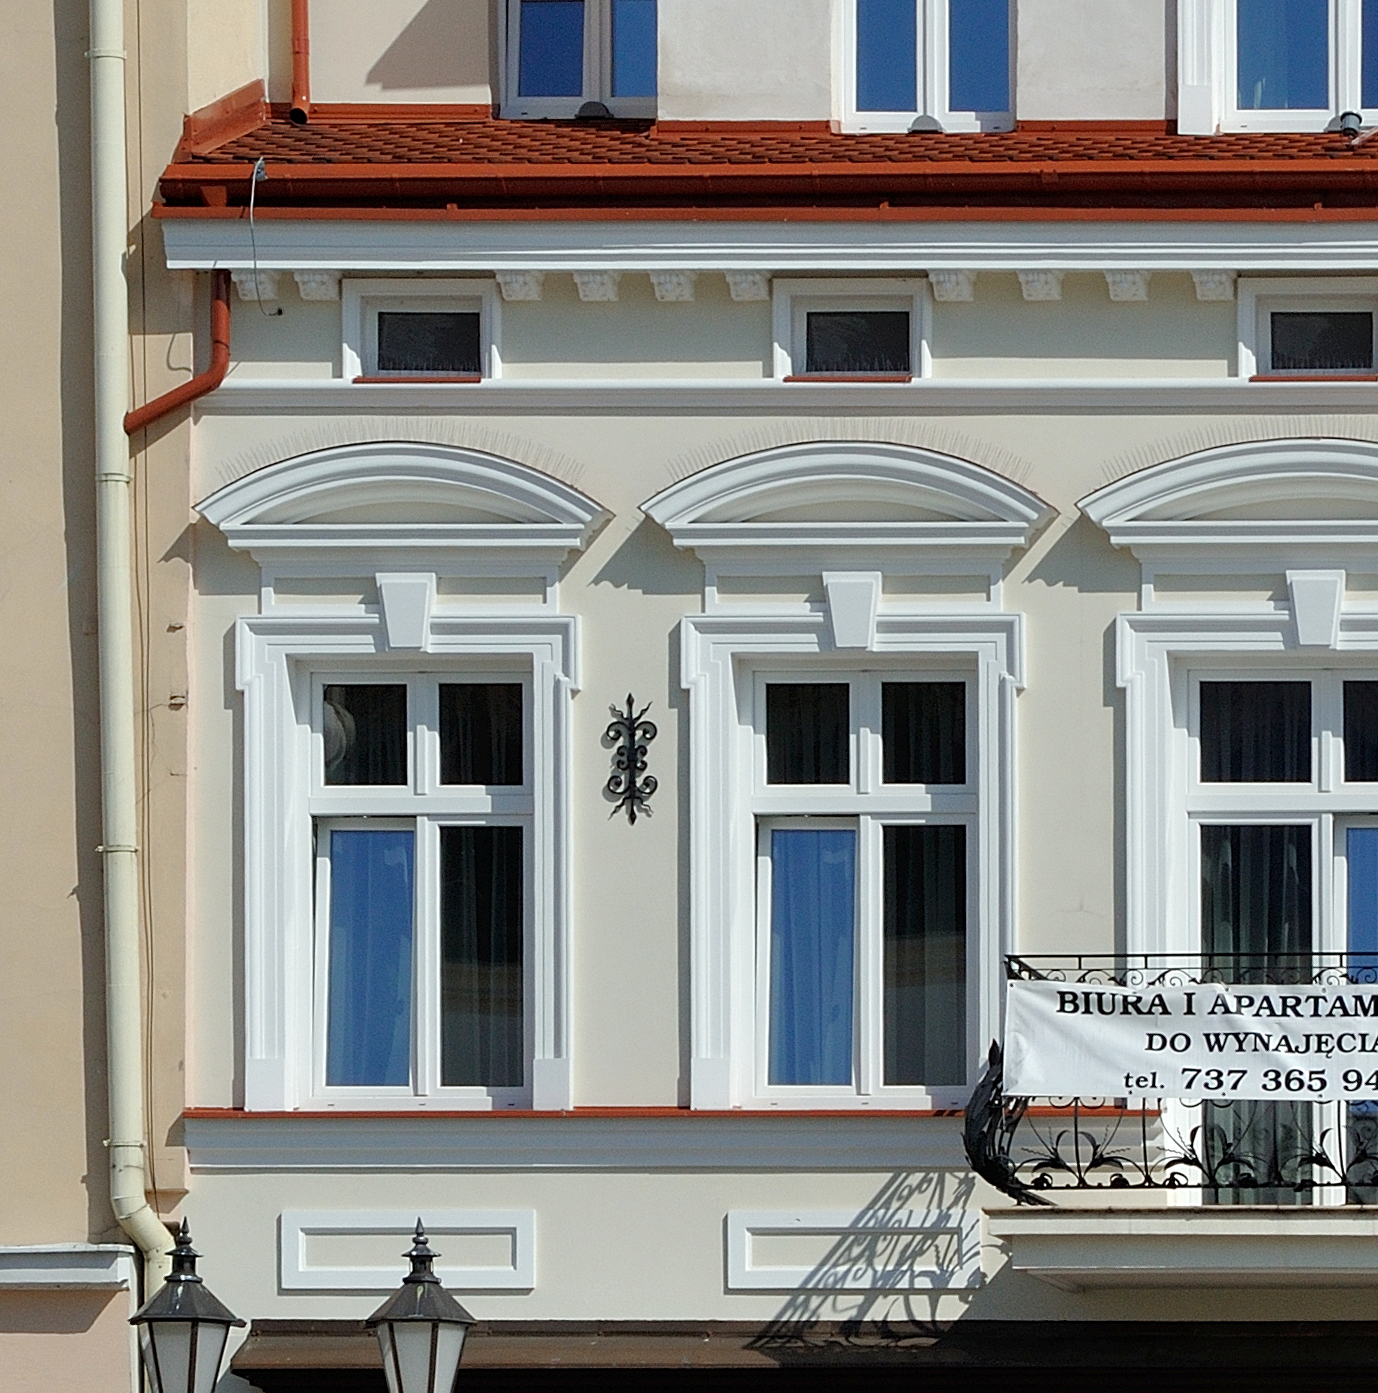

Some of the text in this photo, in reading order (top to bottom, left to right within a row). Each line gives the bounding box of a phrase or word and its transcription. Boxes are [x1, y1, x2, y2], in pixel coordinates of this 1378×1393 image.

[1056, 990, 1172, 1016] BIURA
[1182, 992, 1197, 1017] I
[1144, 1032, 1192, 1053] DO
[1123, 1070, 1166, 1090] tel.
[1180, 1067, 1249, 1092] 737
[1260, 1068, 1328, 1093] 365
